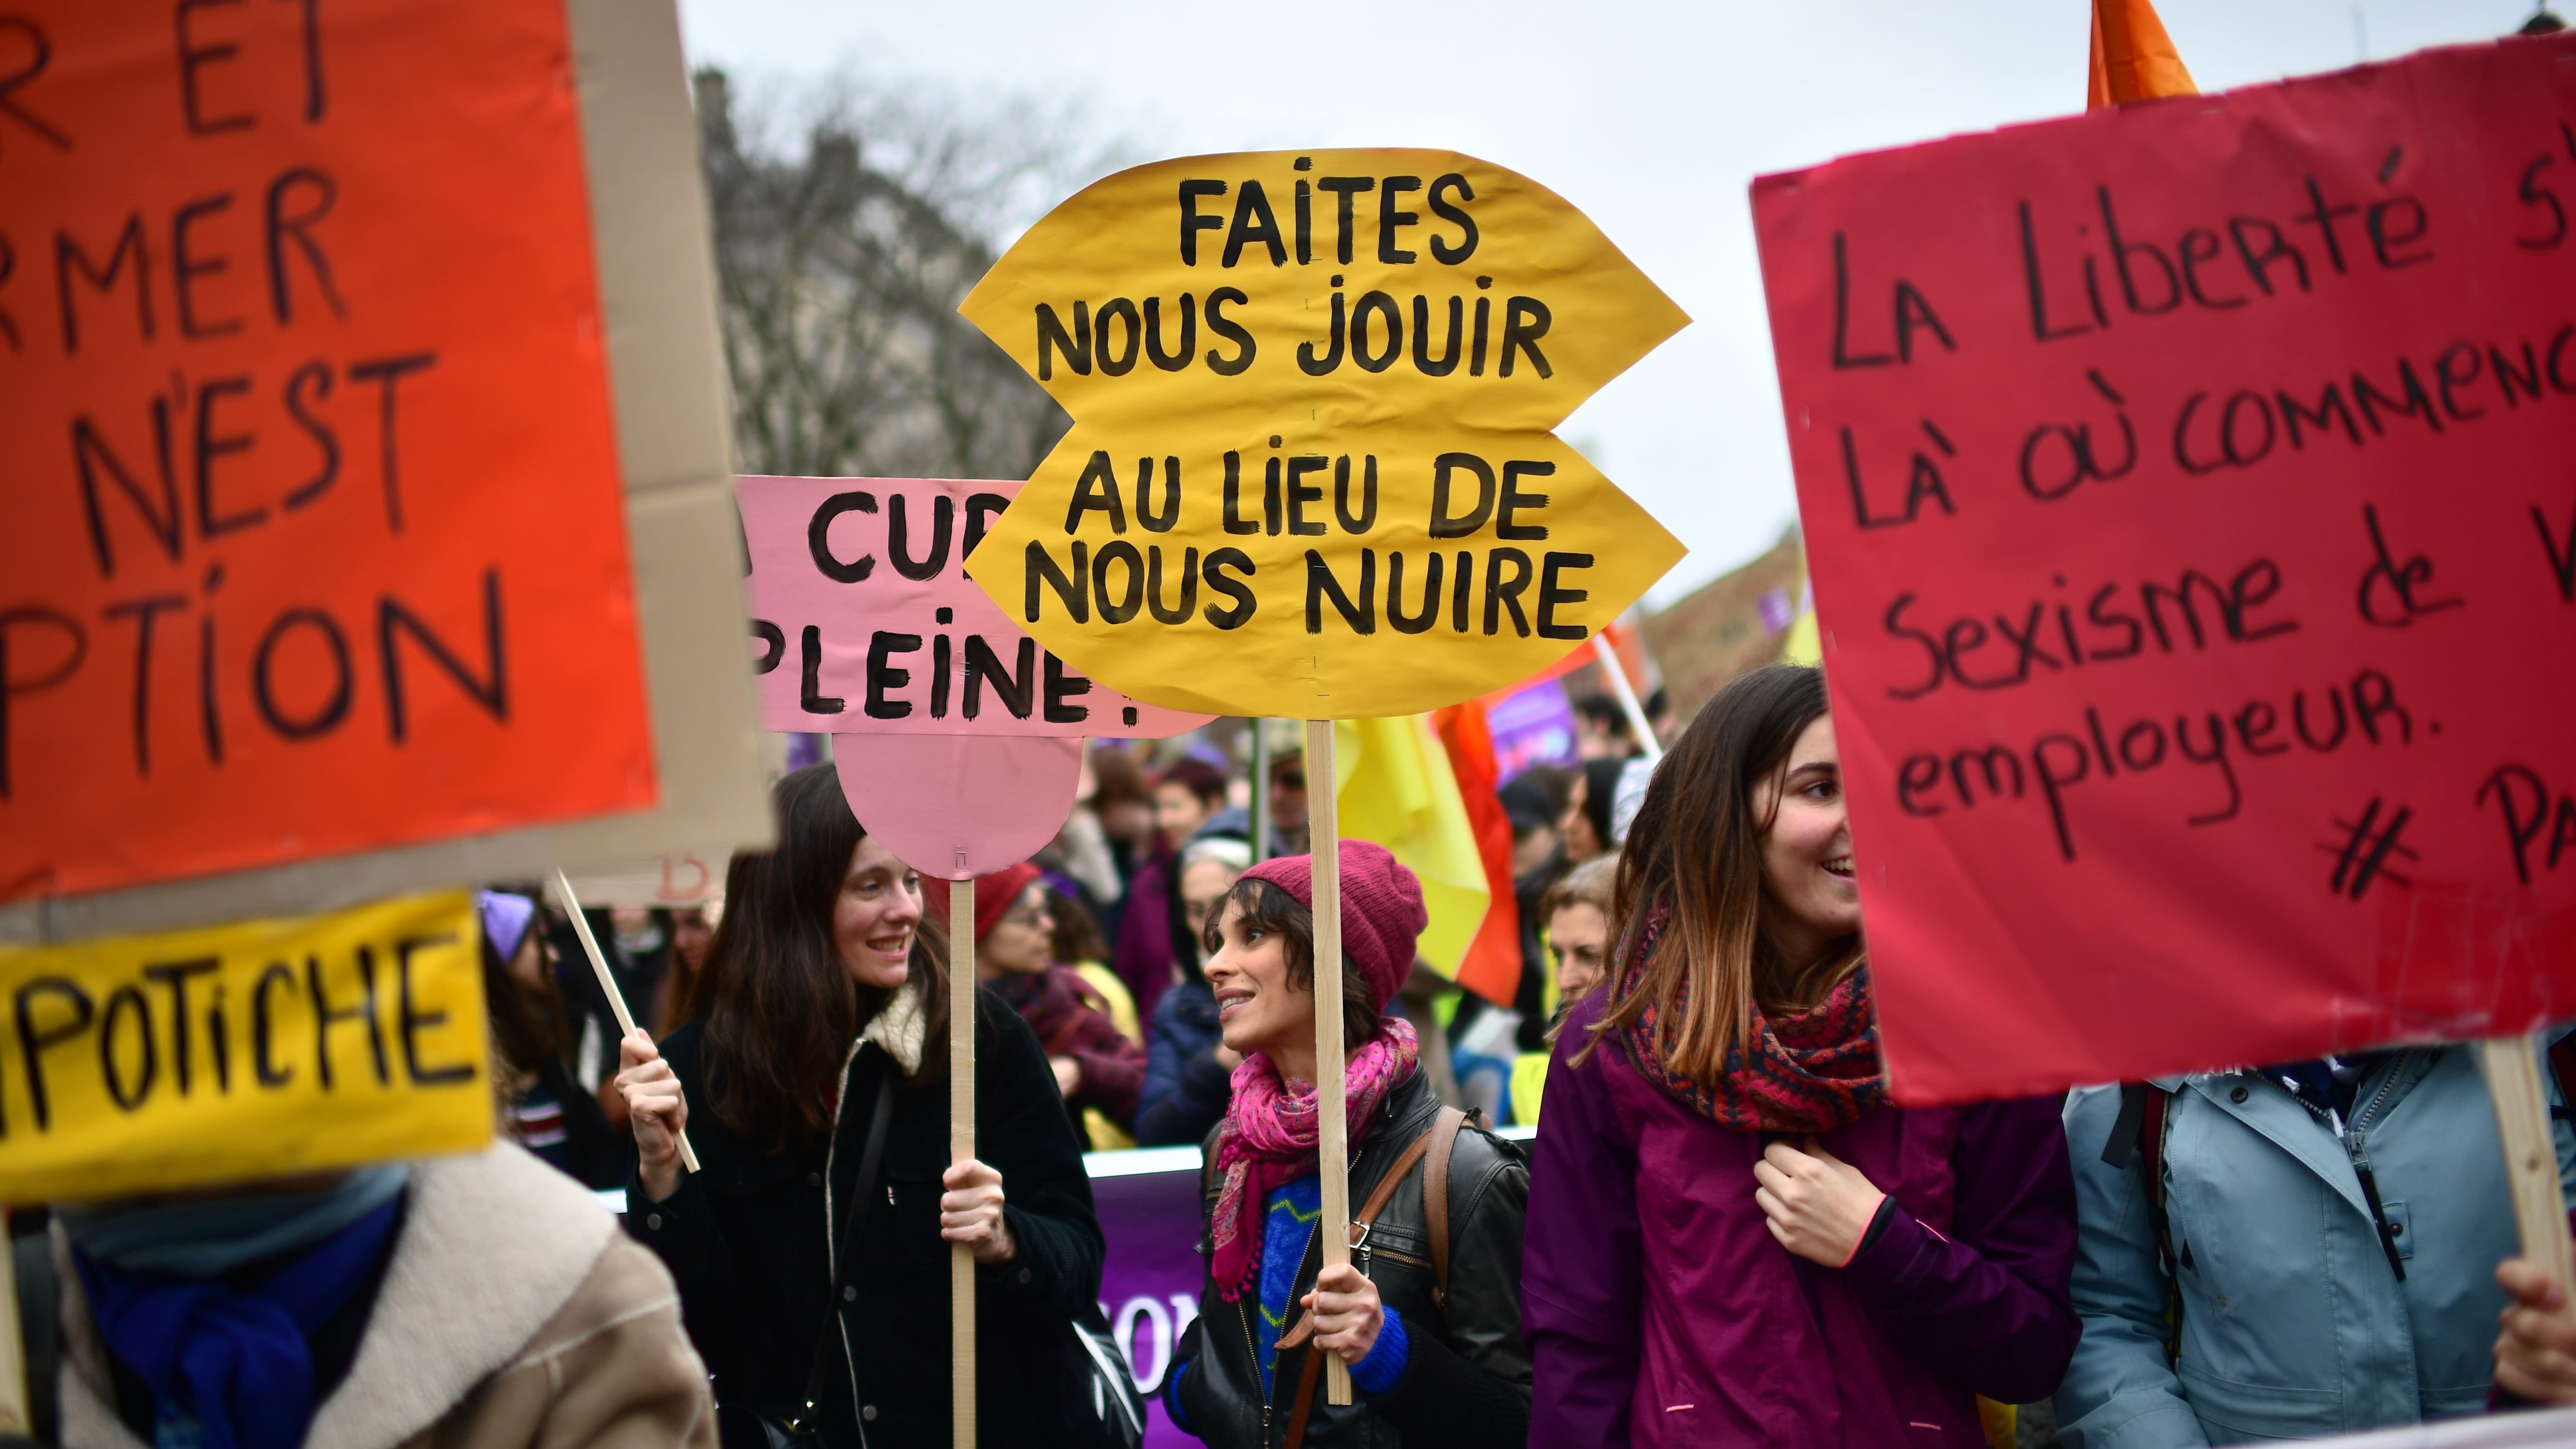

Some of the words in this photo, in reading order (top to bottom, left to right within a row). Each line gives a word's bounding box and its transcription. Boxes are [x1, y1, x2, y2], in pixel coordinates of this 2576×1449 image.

[177, 0, 323, 132] ET
[1035, 287, 1256, 381] NOUS
[1833, 234, 1955, 369] LA
[69, 353, 438, 578] N'EST
[1065, 451, 1181, 535] AU
[1429, 452, 1555, 540] DE
[1840, 420, 1955, 529] LÀ
[1025, 540, 1257, 630] NOUS
[1305, 547, 1594, 639] NUIRE
[1884, 558, 2303, 700] Sexisme
[2358, 504, 2464, 627] de
